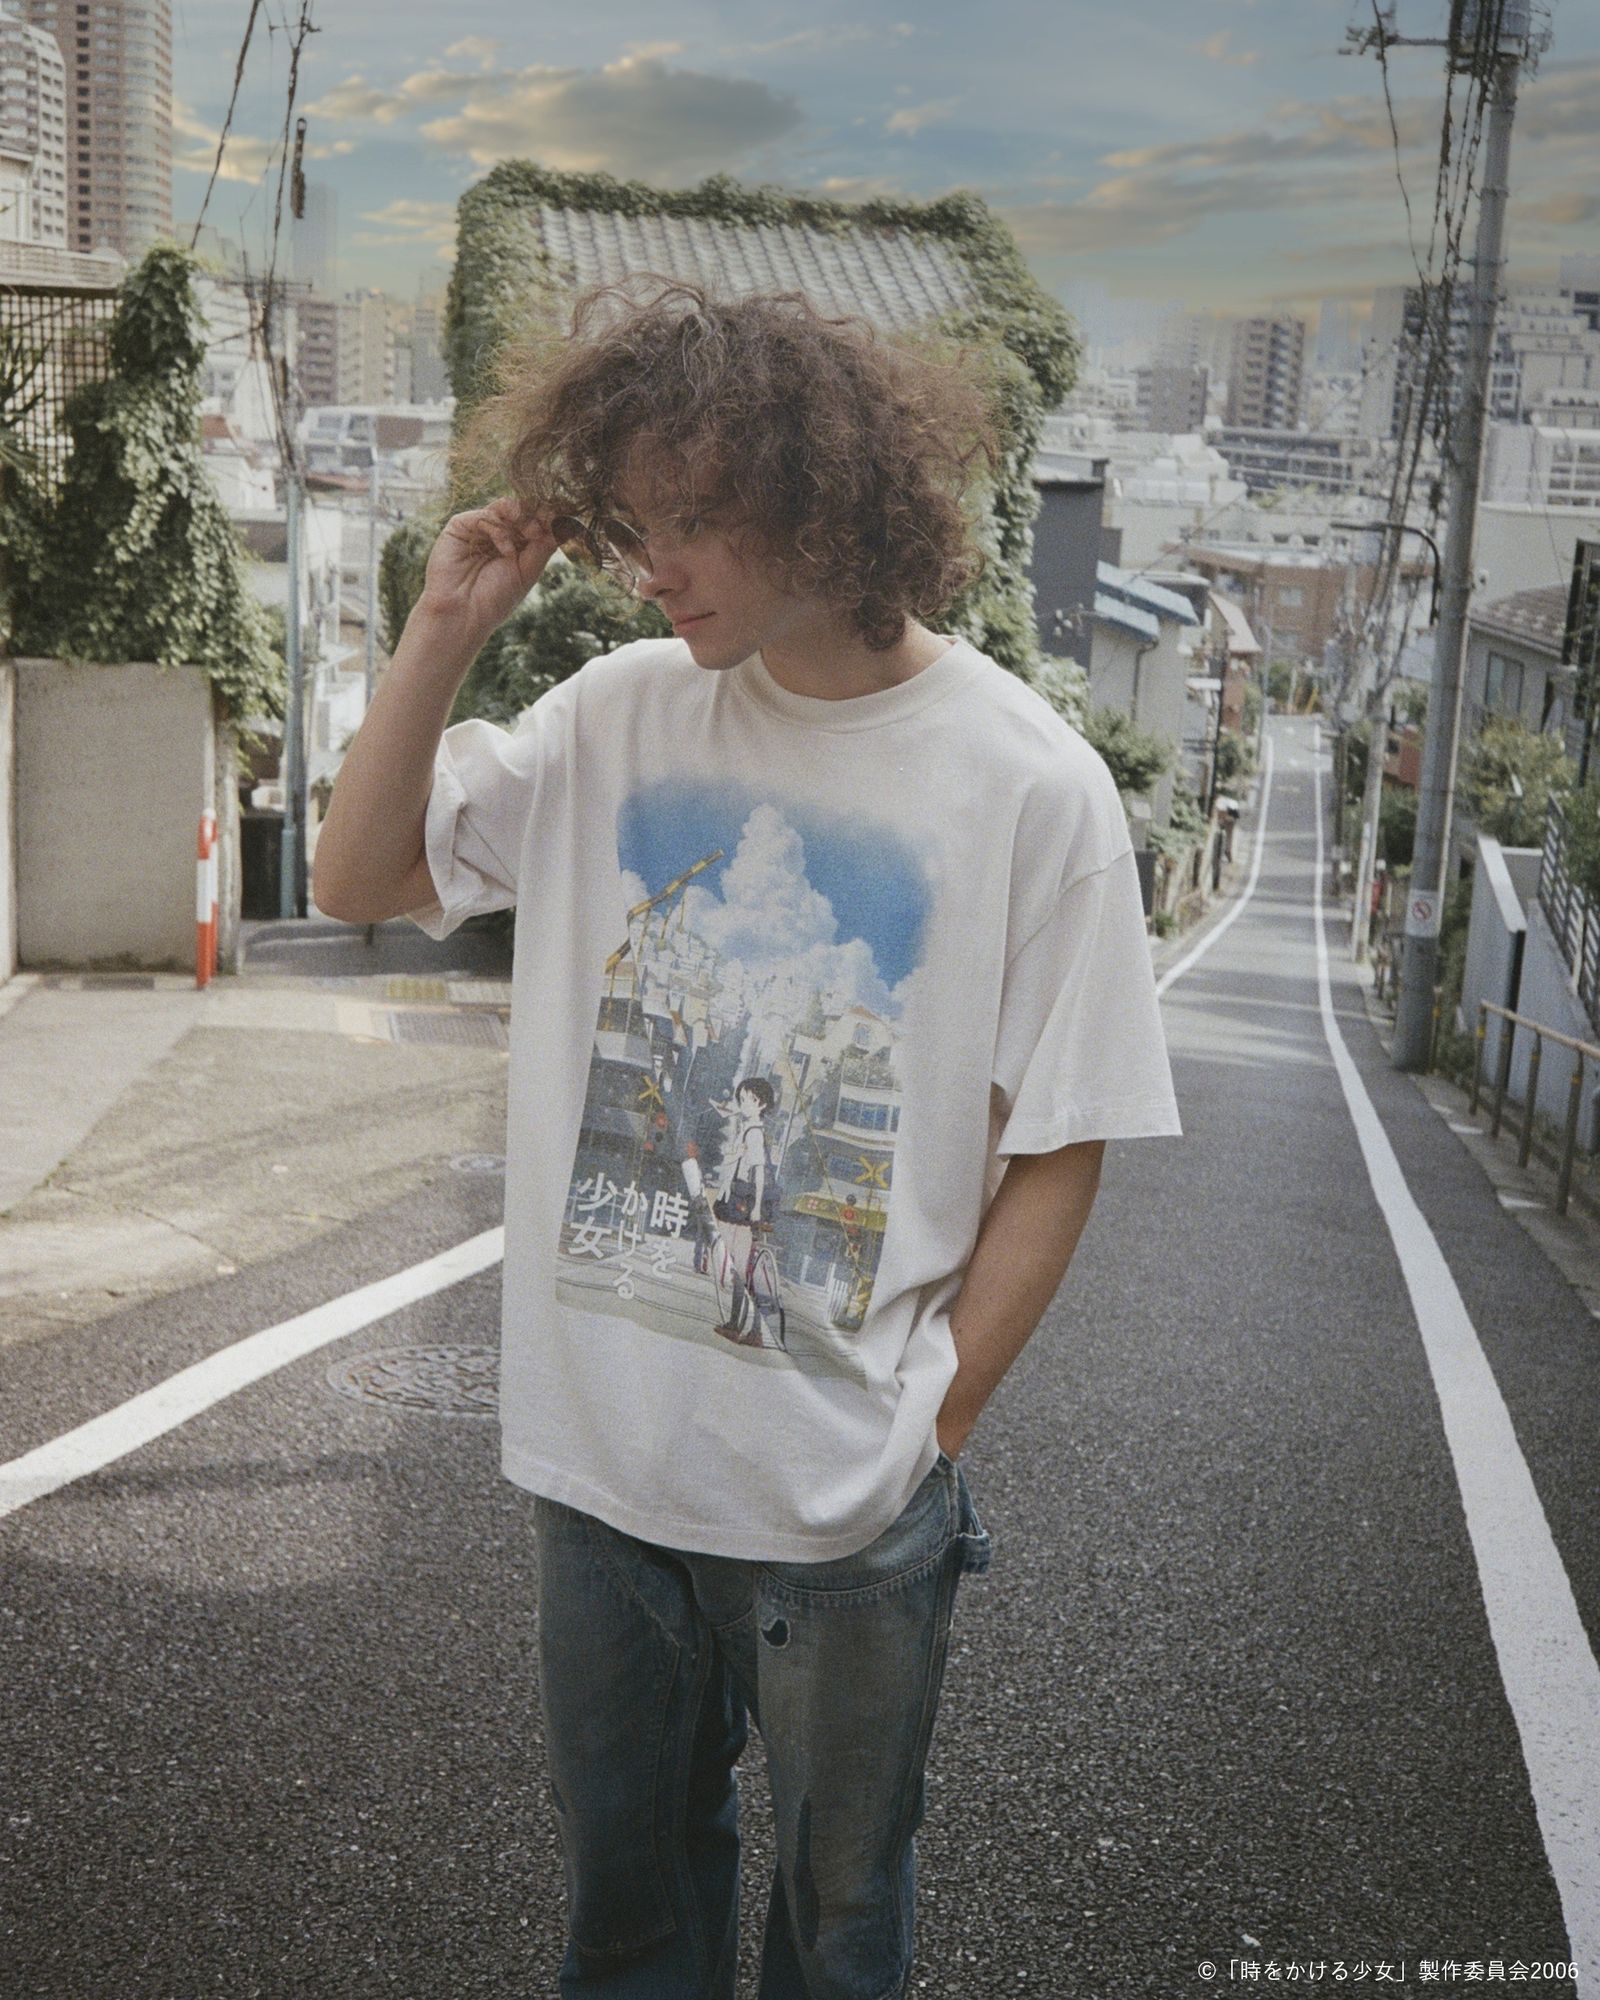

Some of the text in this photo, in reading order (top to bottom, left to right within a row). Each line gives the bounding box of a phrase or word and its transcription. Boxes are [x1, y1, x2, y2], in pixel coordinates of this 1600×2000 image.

[569, 1173, 616, 1259] 少女
[613, 1181, 648, 1299] かける
[651, 1190, 690, 1279] 時を
